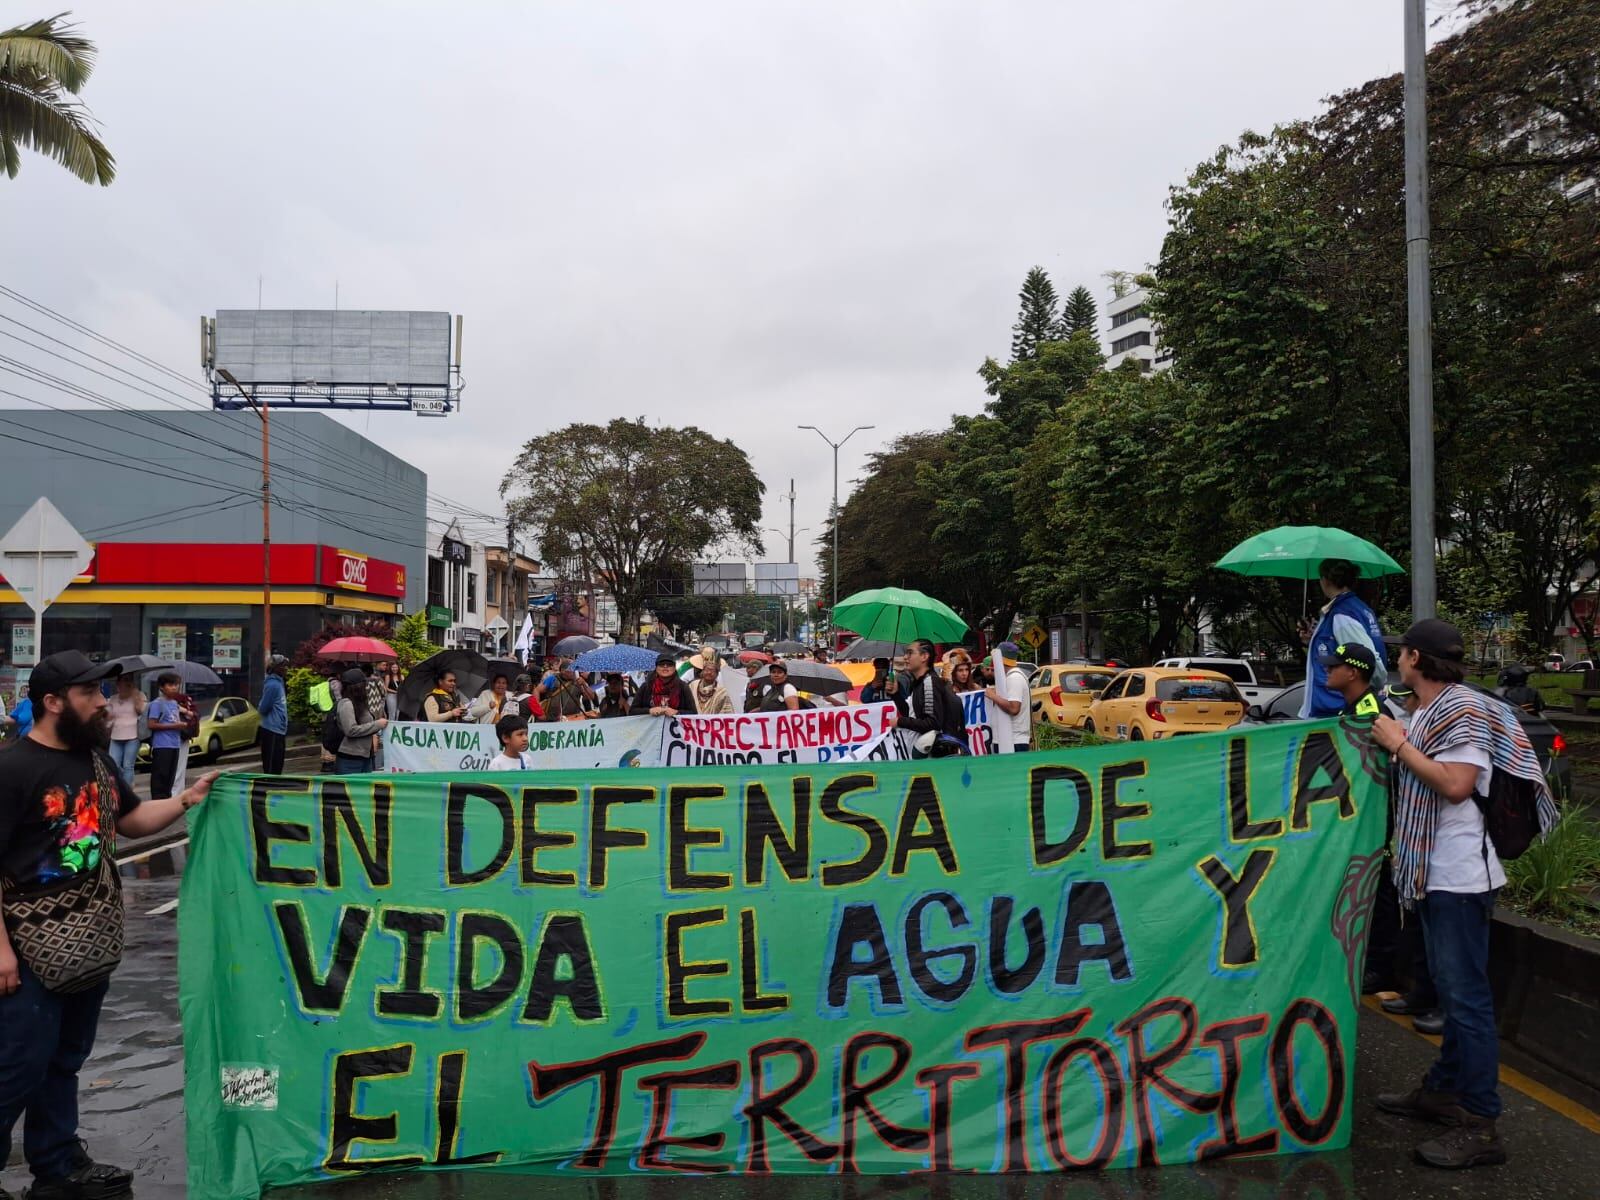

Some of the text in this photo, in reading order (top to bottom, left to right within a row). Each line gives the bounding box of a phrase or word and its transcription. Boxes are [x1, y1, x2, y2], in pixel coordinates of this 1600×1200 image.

[343, 558, 367, 583] OXXO
[249, 729, 1357, 891] EN DEFENSA DE LA
[443, 729, 481, 752] VIDA
[526, 723, 605, 752] OBERANÍA
[271, 847, 1278, 1025] VIDA EL AGUA Y
[321, 996, 1346, 1175] EL TERRITORIO
